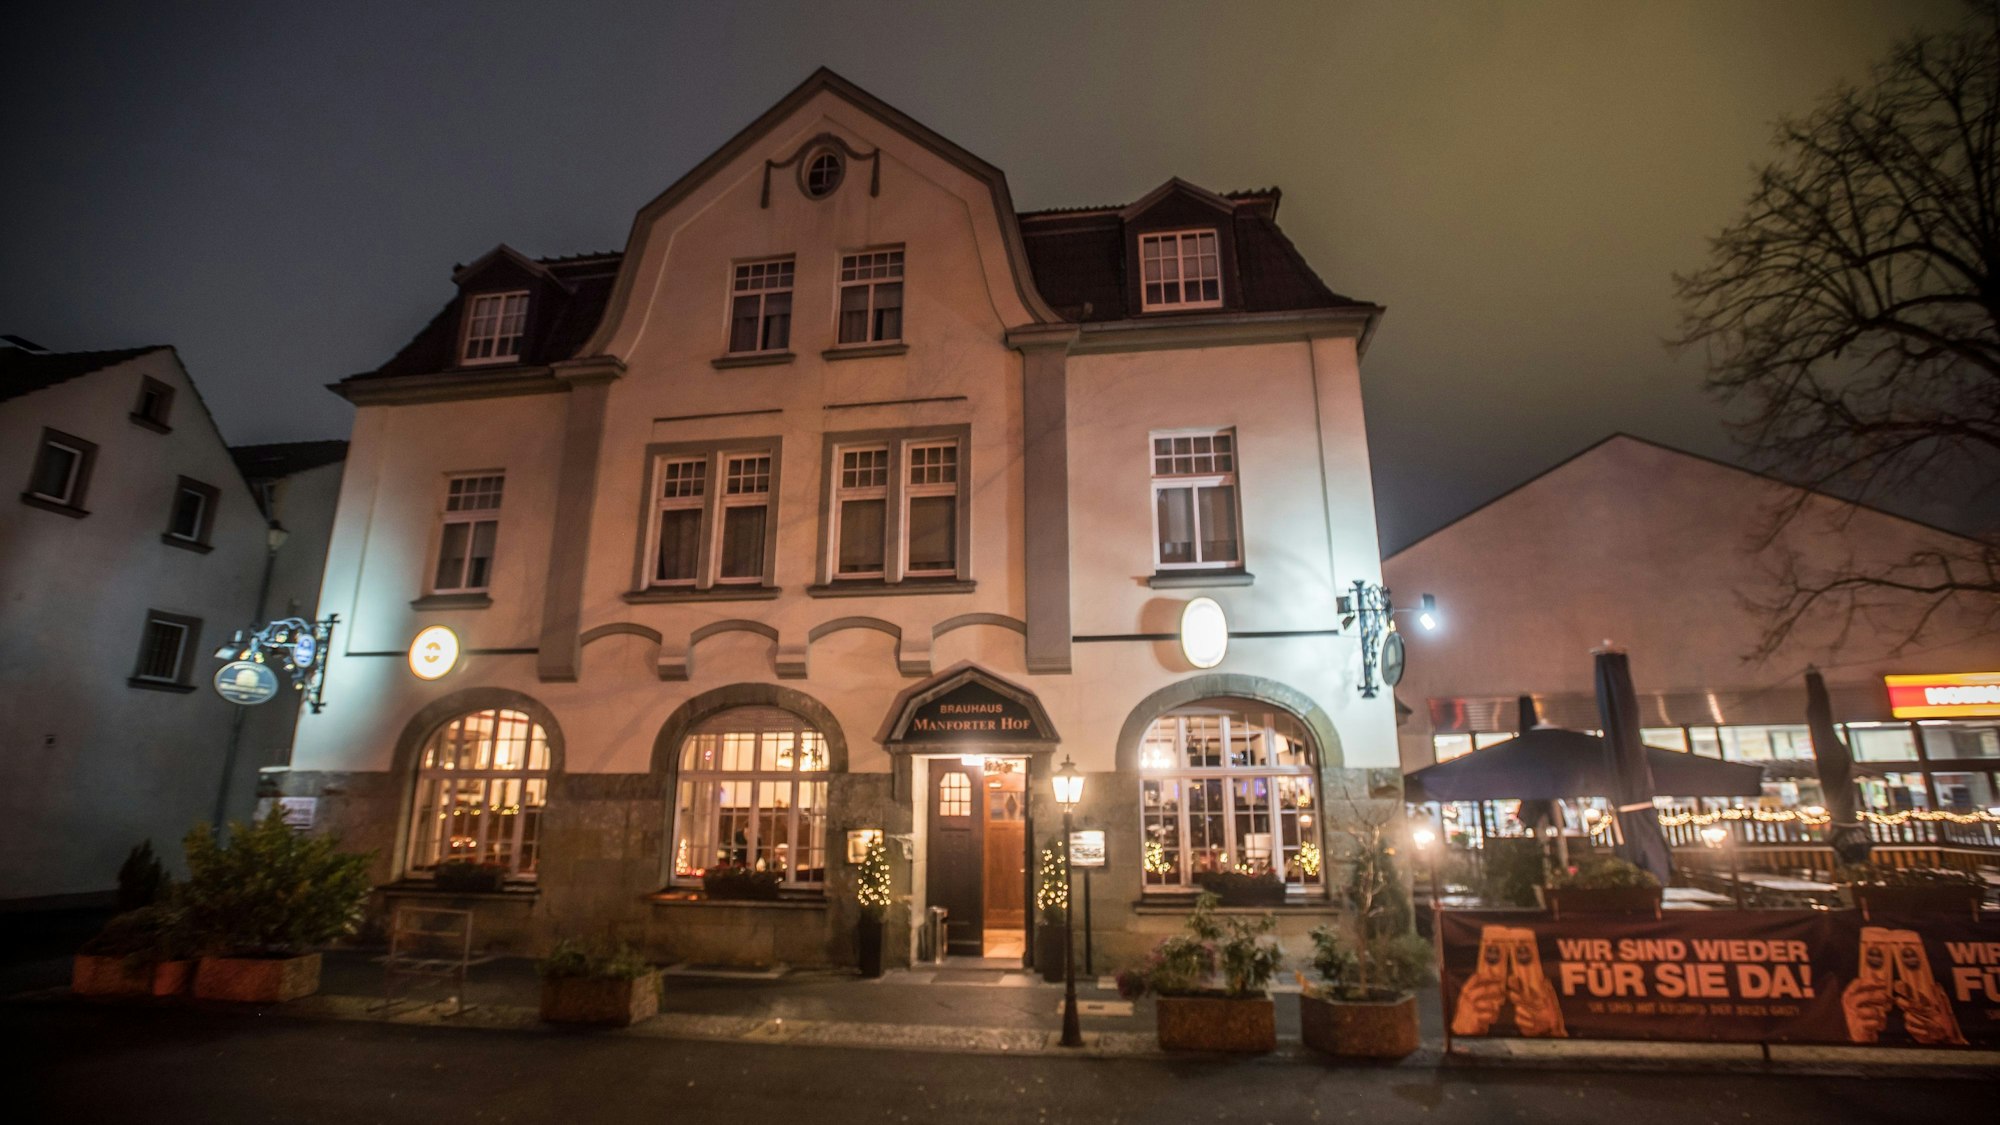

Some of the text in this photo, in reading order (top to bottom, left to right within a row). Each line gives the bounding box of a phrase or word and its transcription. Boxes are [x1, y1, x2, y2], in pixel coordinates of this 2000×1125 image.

[940, 704, 1003, 714] BRAUHAUS
[1557, 938, 1809, 963] WIR SIND WIEDER
[1559, 962, 1815, 999] FÜR SIE DA!
